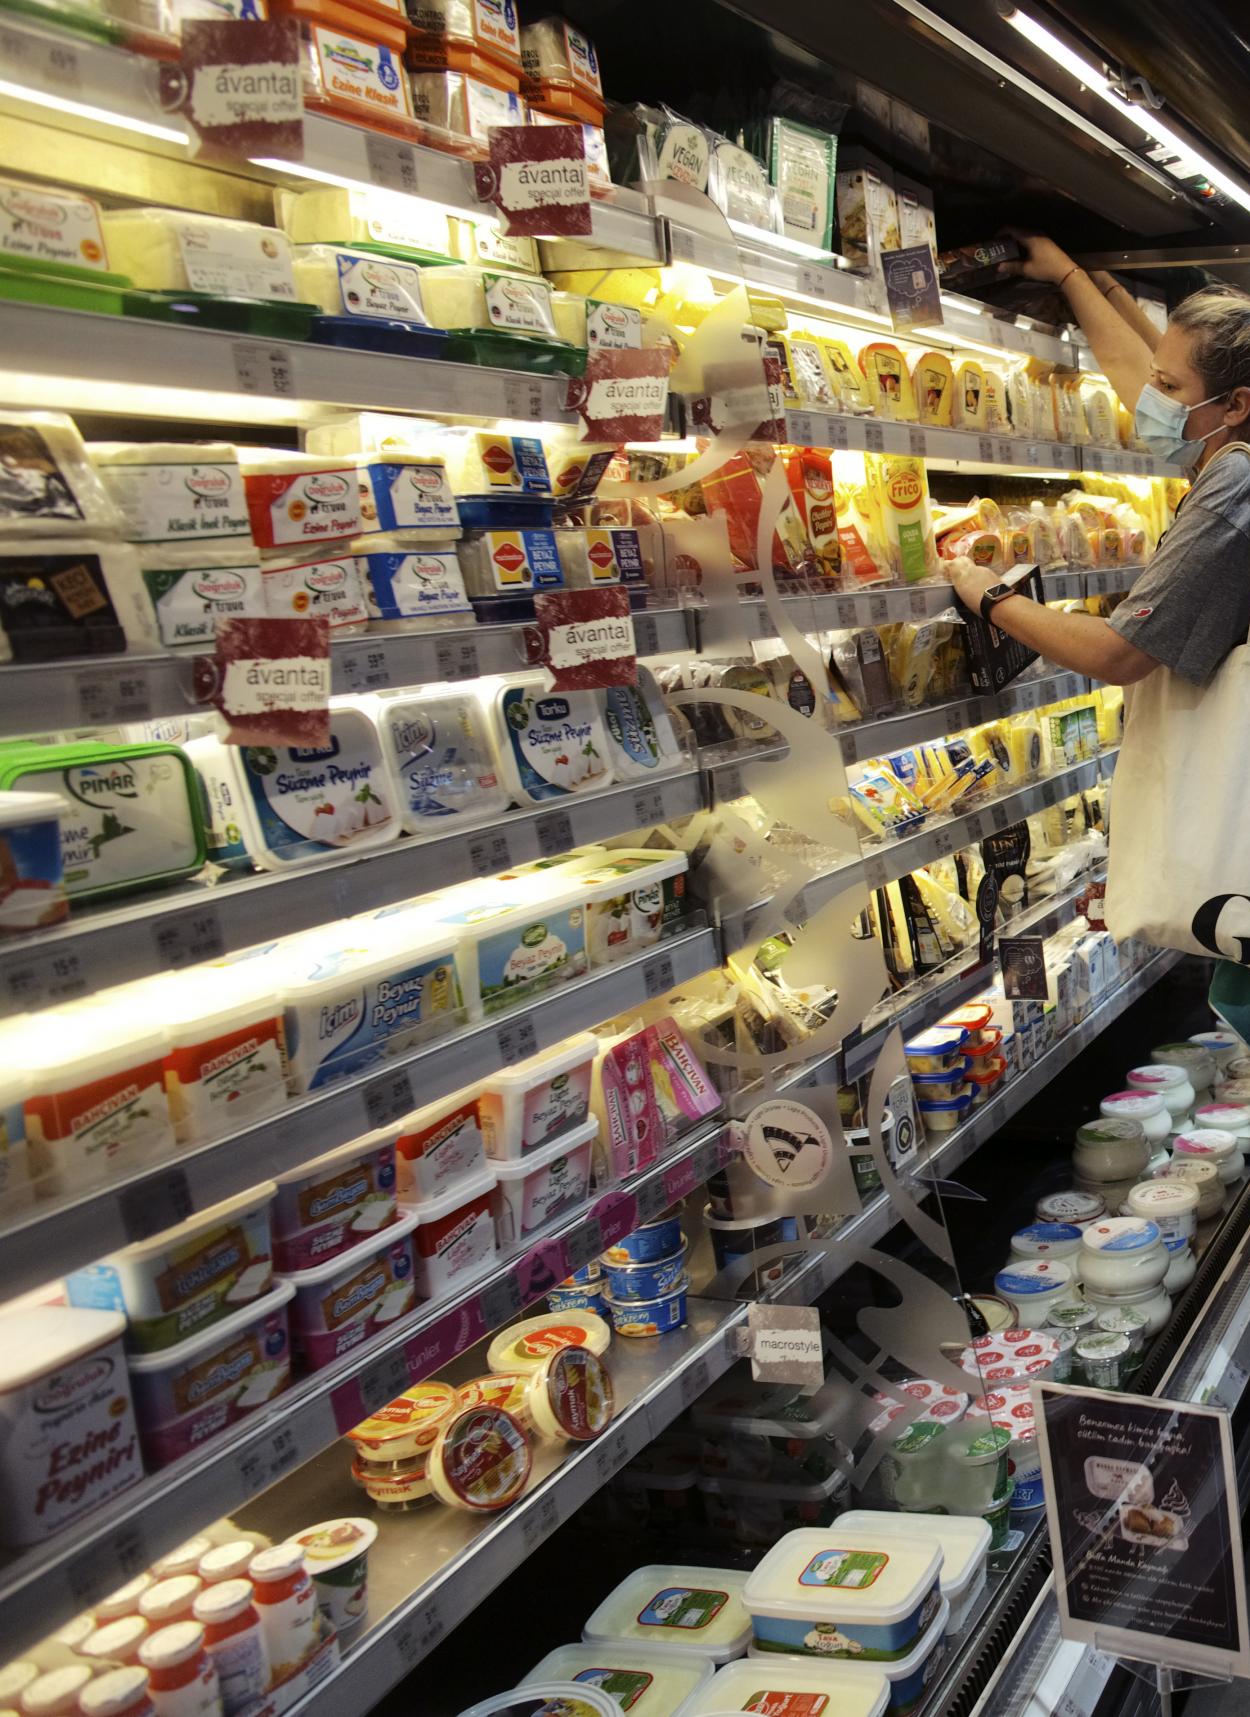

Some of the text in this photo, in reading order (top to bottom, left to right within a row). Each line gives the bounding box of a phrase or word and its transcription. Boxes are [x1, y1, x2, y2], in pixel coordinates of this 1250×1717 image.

[332, 77, 364, 97] Ezine
[364, 86, 399, 108] Klasik
[673, 144, 703, 174] VEGAN
[528, 187, 586, 201] special offer
[521, 456, 543, 467] BEYAZ
[891, 480, 920, 498] Frico
[414, 503, 434, 516] Beyaz
[167, 516, 198, 533] Klasik
[302, 516, 360, 535] Ezine Peyniri
[532, 549, 555, 561] BEYAZ
[620, 548, 638, 559] BEYAZ
[417, 590, 440, 604] Beyaz
[214, 600, 245, 613] truva
[174, 624, 209, 638] Klasik
[575, 642, 632, 657] special offer
[539, 702, 567, 716] Torku
[528, 729, 562, 746] Süzme
[563, 720, 592, 743] Peynir
[277, 762, 372, 794] Süzme Peynir
[510, 943, 566, 972] Beyaz Peynir
[378, 975, 424, 1004] Beyaz
[371, 996, 421, 1028] Peynir
[664, 1032, 707, 1096] BAHÇIVAN
[760, 1338, 821, 1354] macrostyle
[406, 1340, 441, 1374] rünler
[1079, 1414, 1154, 1436] Benzemez kimse
[48, 1420, 122, 1478] Ezine
[34, 1433, 136, 1517] Peyniri
[1107, 1555, 1136, 1568] Manda
